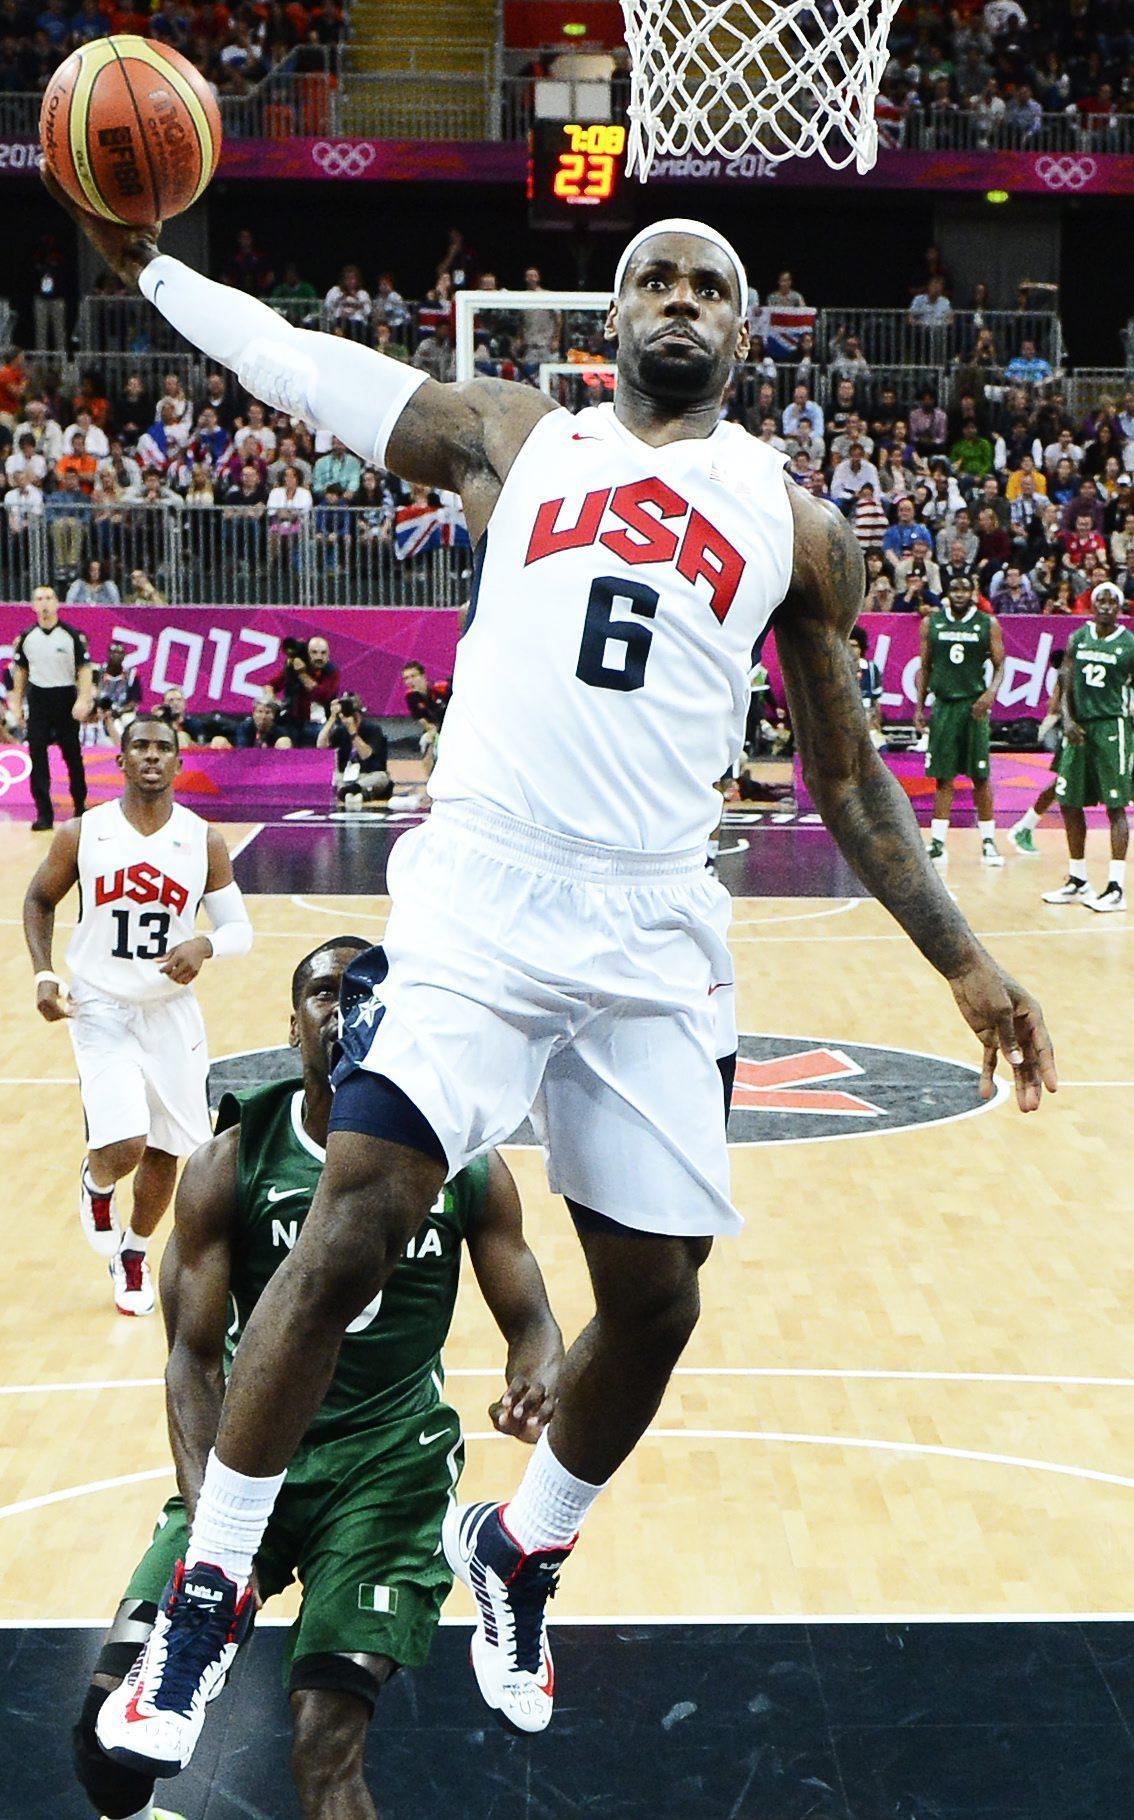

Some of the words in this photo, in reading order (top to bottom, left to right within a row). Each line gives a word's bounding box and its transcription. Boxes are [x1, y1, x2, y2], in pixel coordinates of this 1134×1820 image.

[563, 125, 625, 154] 7:08
[554, 154, 614, 197] 23
[725, 153, 781, 177] 2012
[524, 476, 746, 625] USA
[576, 575, 660, 692] 6
[949, 643, 965, 664] 6
[112, 626, 281, 701] 2012
[1081, 663, 1107, 688] 12
[95, 861, 189, 917] USA
[110, 909, 171, 960] 13
